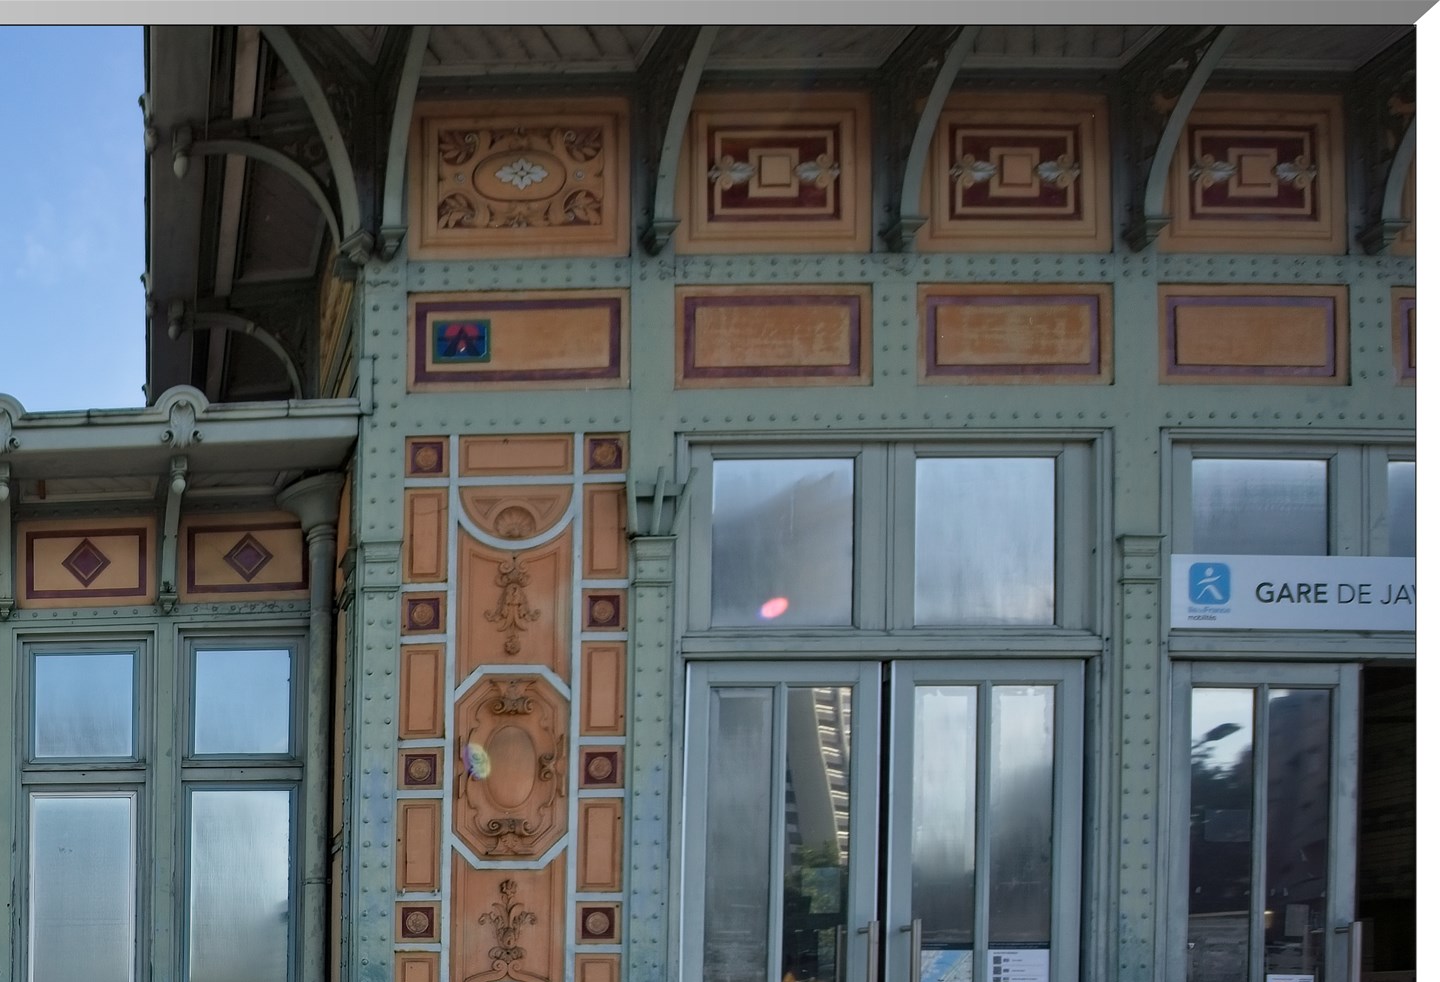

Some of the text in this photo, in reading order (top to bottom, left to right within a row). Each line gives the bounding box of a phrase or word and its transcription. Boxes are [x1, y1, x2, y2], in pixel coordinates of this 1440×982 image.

[1255, 582, 1415, 605] GARE DE JA
